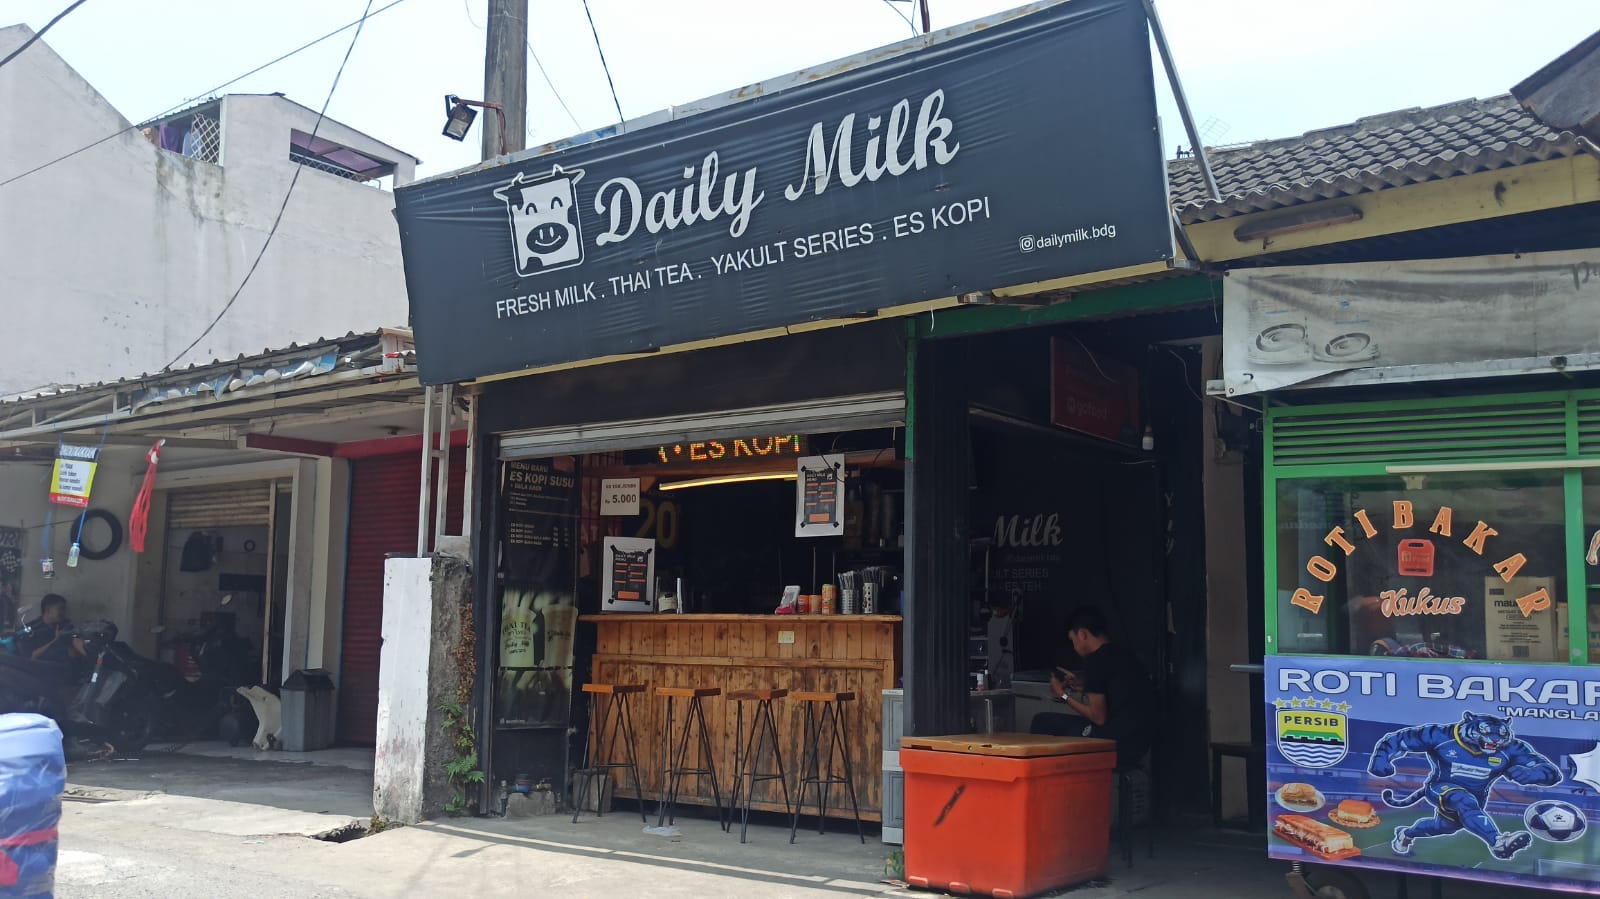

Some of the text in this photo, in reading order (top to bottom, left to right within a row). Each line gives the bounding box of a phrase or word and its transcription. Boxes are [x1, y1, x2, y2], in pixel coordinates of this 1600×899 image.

[594, 88, 960, 247] Daily Milk
[1036, 224, 1117, 249] dailymilk.bdg
[495, 196, 990, 319] FRESH MILK THAI TEA YAKULT SERIES ES KOPI
[510, 471, 574, 488] ES KOPI SUSU
[612, 494, 637, 504] 5.000
[992, 511, 1065, 548] Milk
[1289, 508, 1378, 615] ROTI
[1391, 499, 1552, 618] BAKAR
[1012, 567, 1049, 578] SERIES
[1378, 586, 1466, 618] Kukus
[1278, 667, 1397, 697] ROTI
[1283, 714, 1339, 728] PERSIB
[1498, 706, 1600, 721] "MANGLA
